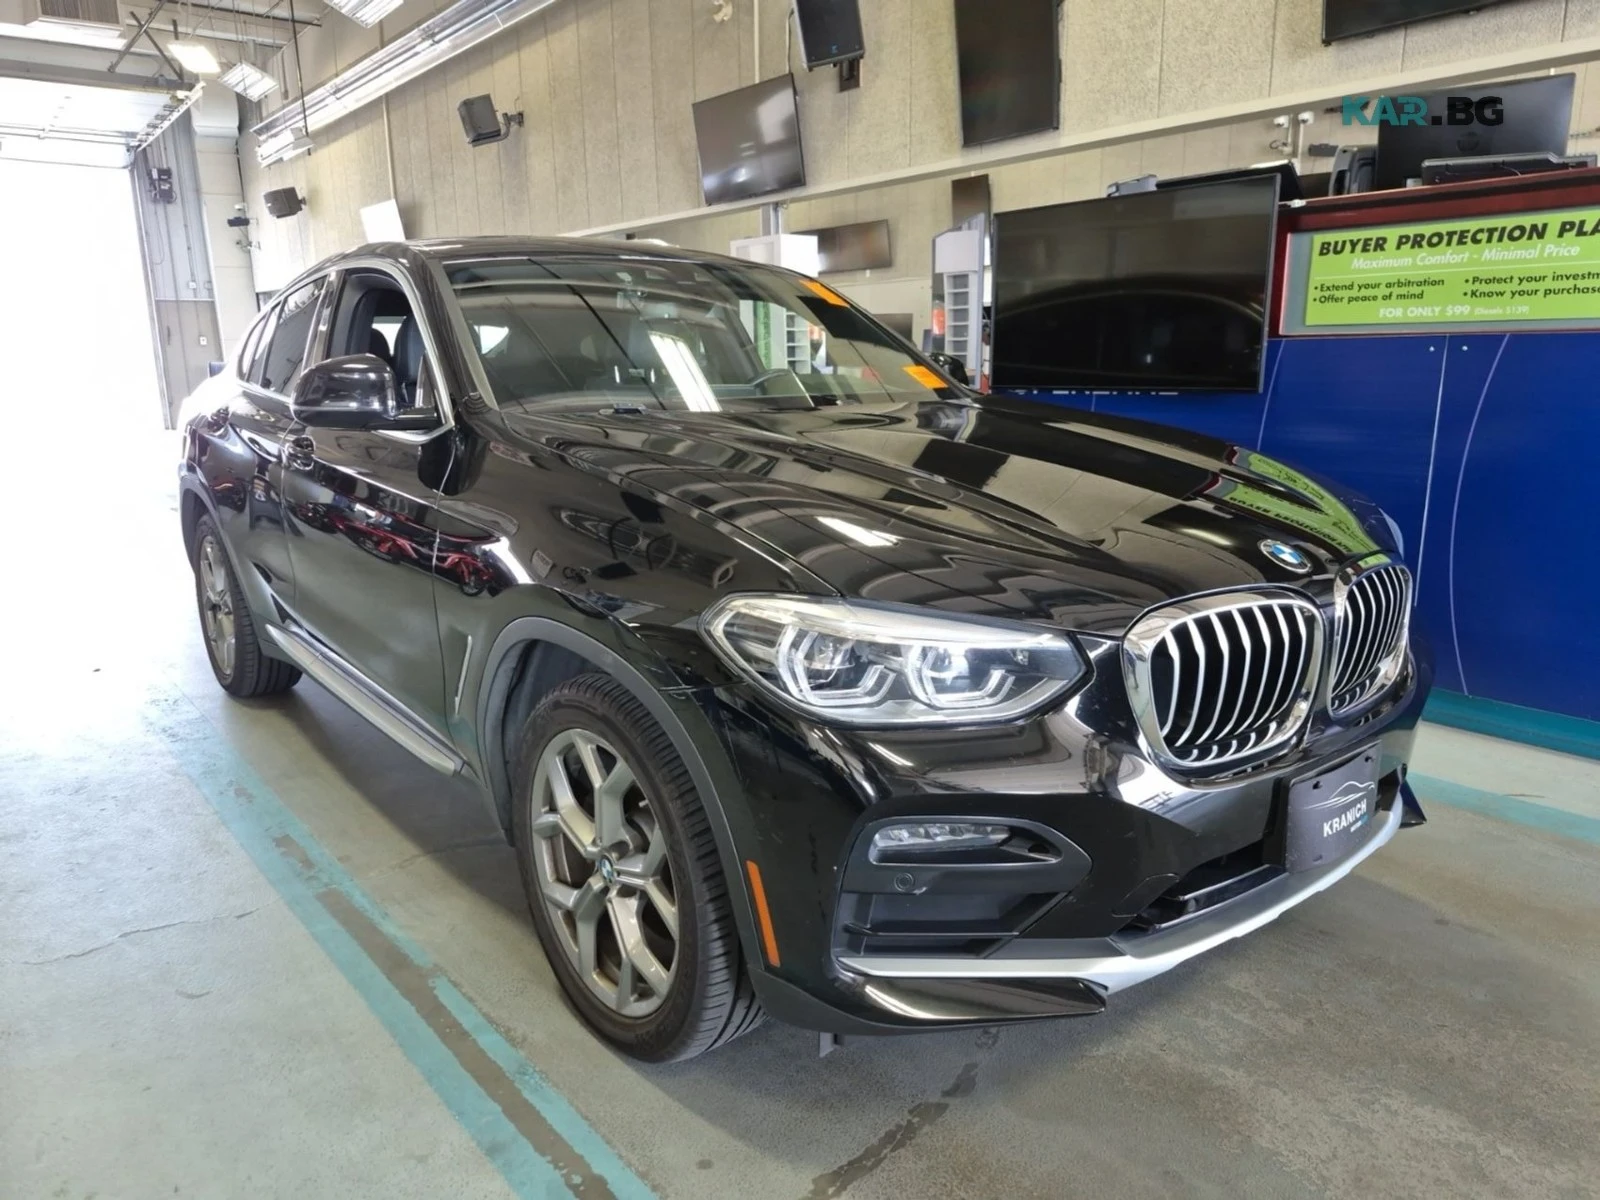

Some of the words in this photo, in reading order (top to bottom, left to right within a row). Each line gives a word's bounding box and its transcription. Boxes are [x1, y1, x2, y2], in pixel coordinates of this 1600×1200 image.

[1318, 236, 1388, 256] BUYER
[1395, 222, 1549, 251] PROTECTION
[1351, 256, 1412, 269] Maximum
[1416, 249, 1470, 266] Comfort
[1481, 243, 1541, 261] Minimal
[1544, 242, 1580, 258] Price
[1319, 281, 1354, 292] Extend
[1357, 282, 1382, 292] your
[1385, 277, 1445, 289] arbitration
[1471, 275, 1514, 285] Protect
[1517, 274, 1548, 286] your
[1318, 294, 1345, 304] Offer
[1347, 295, 1378, 304] peace
[1381, 291, 1394, 301] of
[1396, 290, 1424, 300] mind
[1470, 288, 1506, 299] Know
[1510, 288, 1540, 299] your
[1379, 307, 1404, 318] FOR
[1406, 306, 1442, 317] ONLY
[1445, 304, 1471, 316] $99
[1323, 798, 1367, 837] KRANICH
